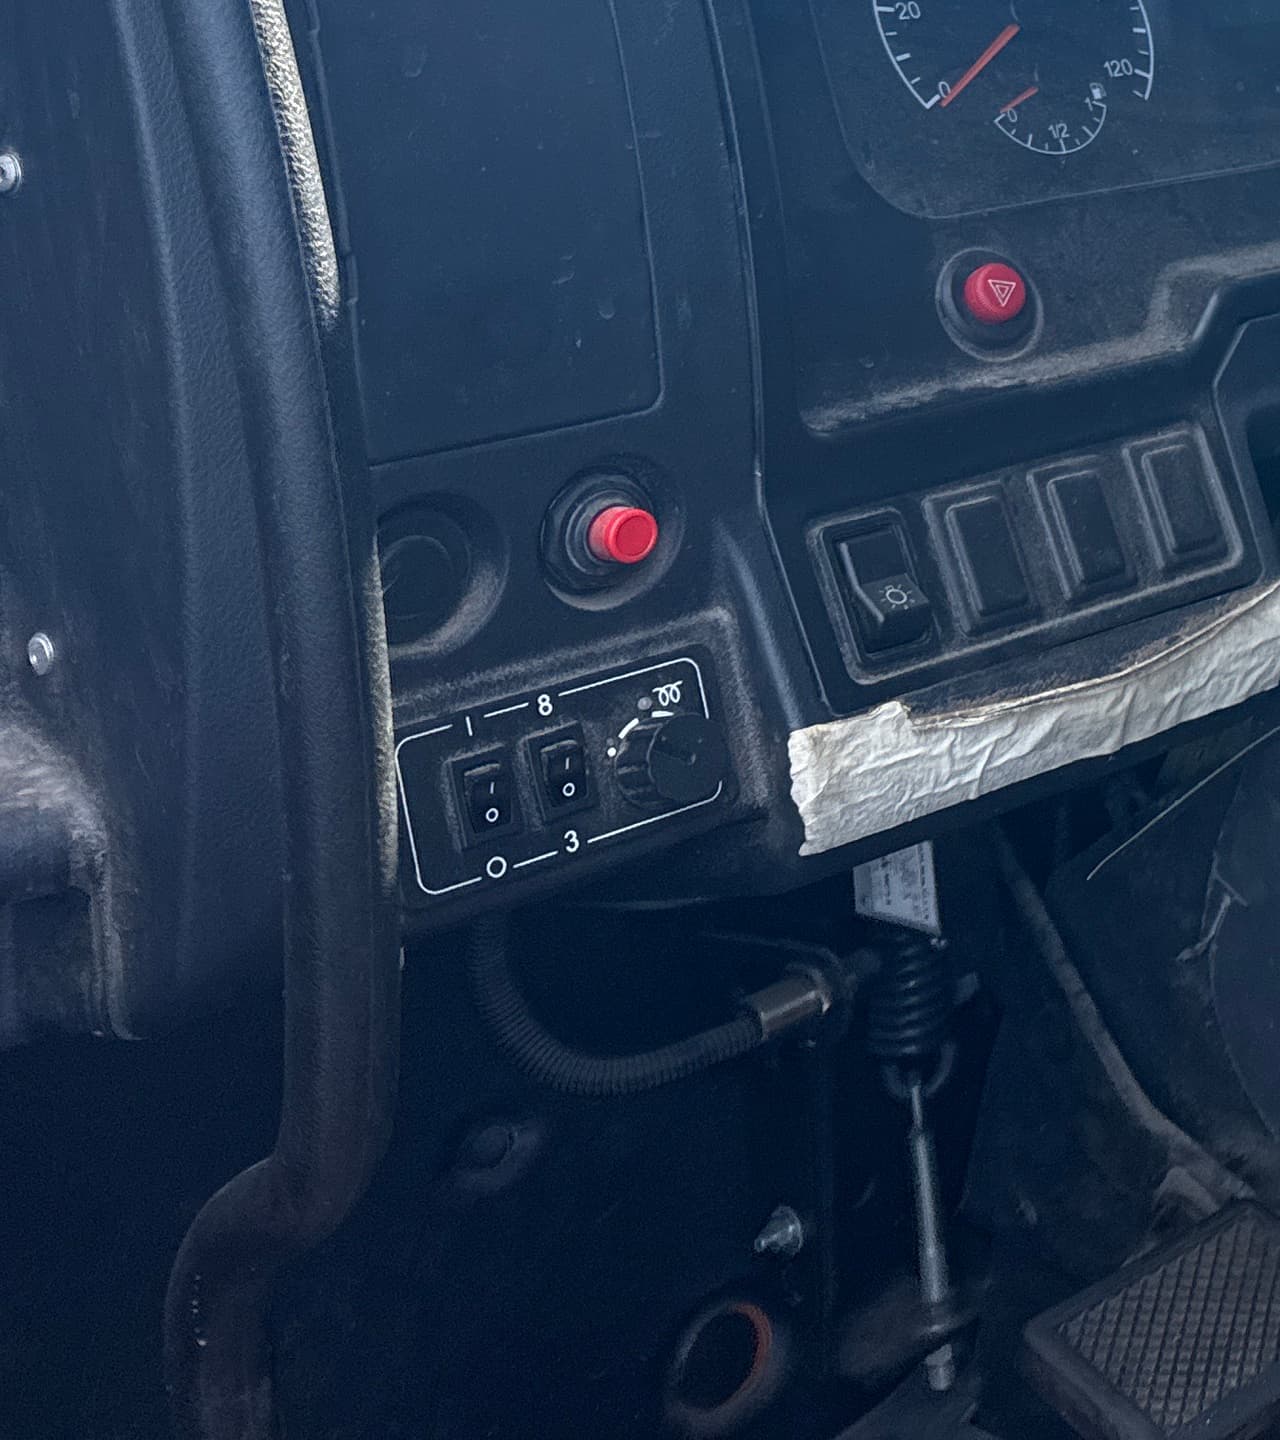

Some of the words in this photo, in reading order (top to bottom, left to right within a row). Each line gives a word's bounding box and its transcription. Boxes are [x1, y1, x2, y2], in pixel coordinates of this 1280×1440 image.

[895, 1, 921, 20] 20
[1103, 58, 1133, 78] 120
[937, 80, 952, 99] 0
[1006, 107, 1018, 123] 0
[1047, 122, 1070, 139] 1/2
[536, 693, 553, 716] 8
[563, 830, 580, 853] 3
